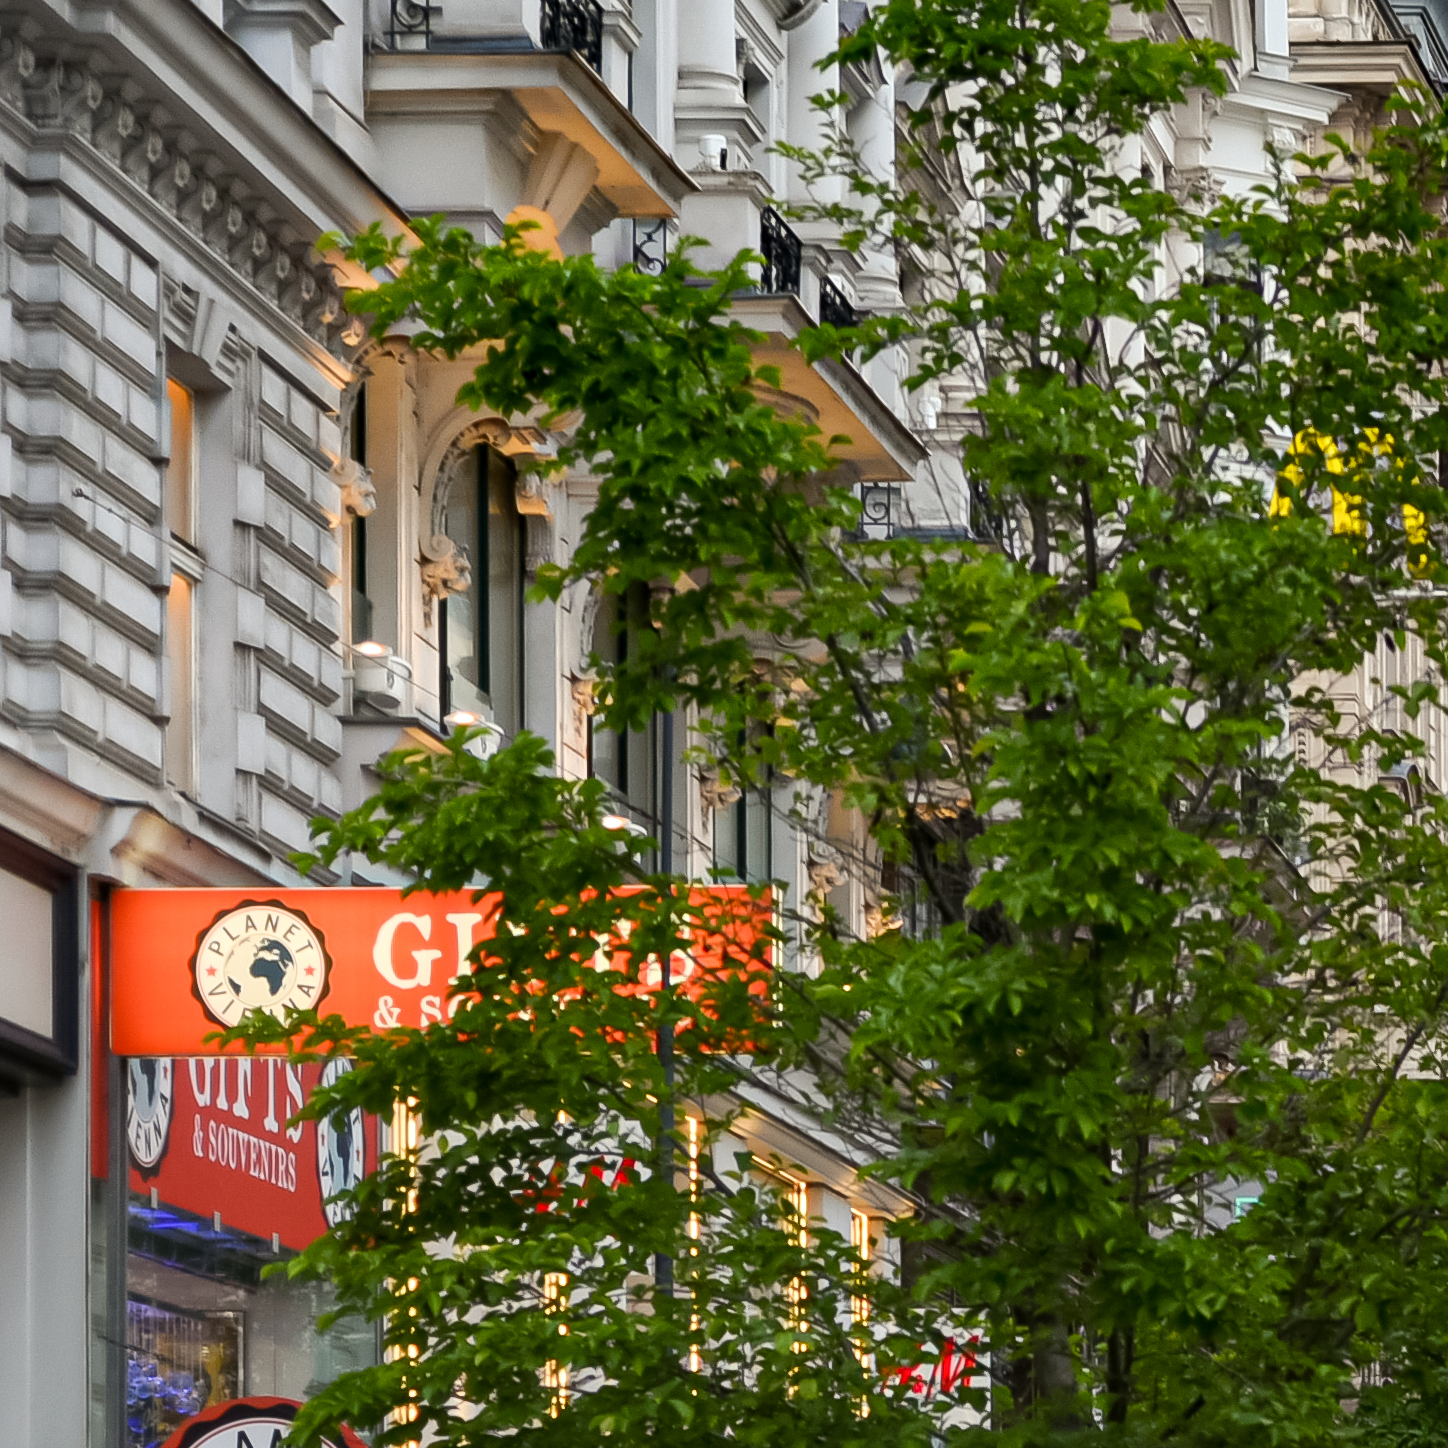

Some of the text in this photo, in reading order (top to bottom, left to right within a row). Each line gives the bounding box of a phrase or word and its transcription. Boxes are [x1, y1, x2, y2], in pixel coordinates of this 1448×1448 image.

[207, 913, 314, 957] PLANET
[207, 982, 316, 1023] VINA
[208, 1119, 297, 1193] SOUVENIRS
